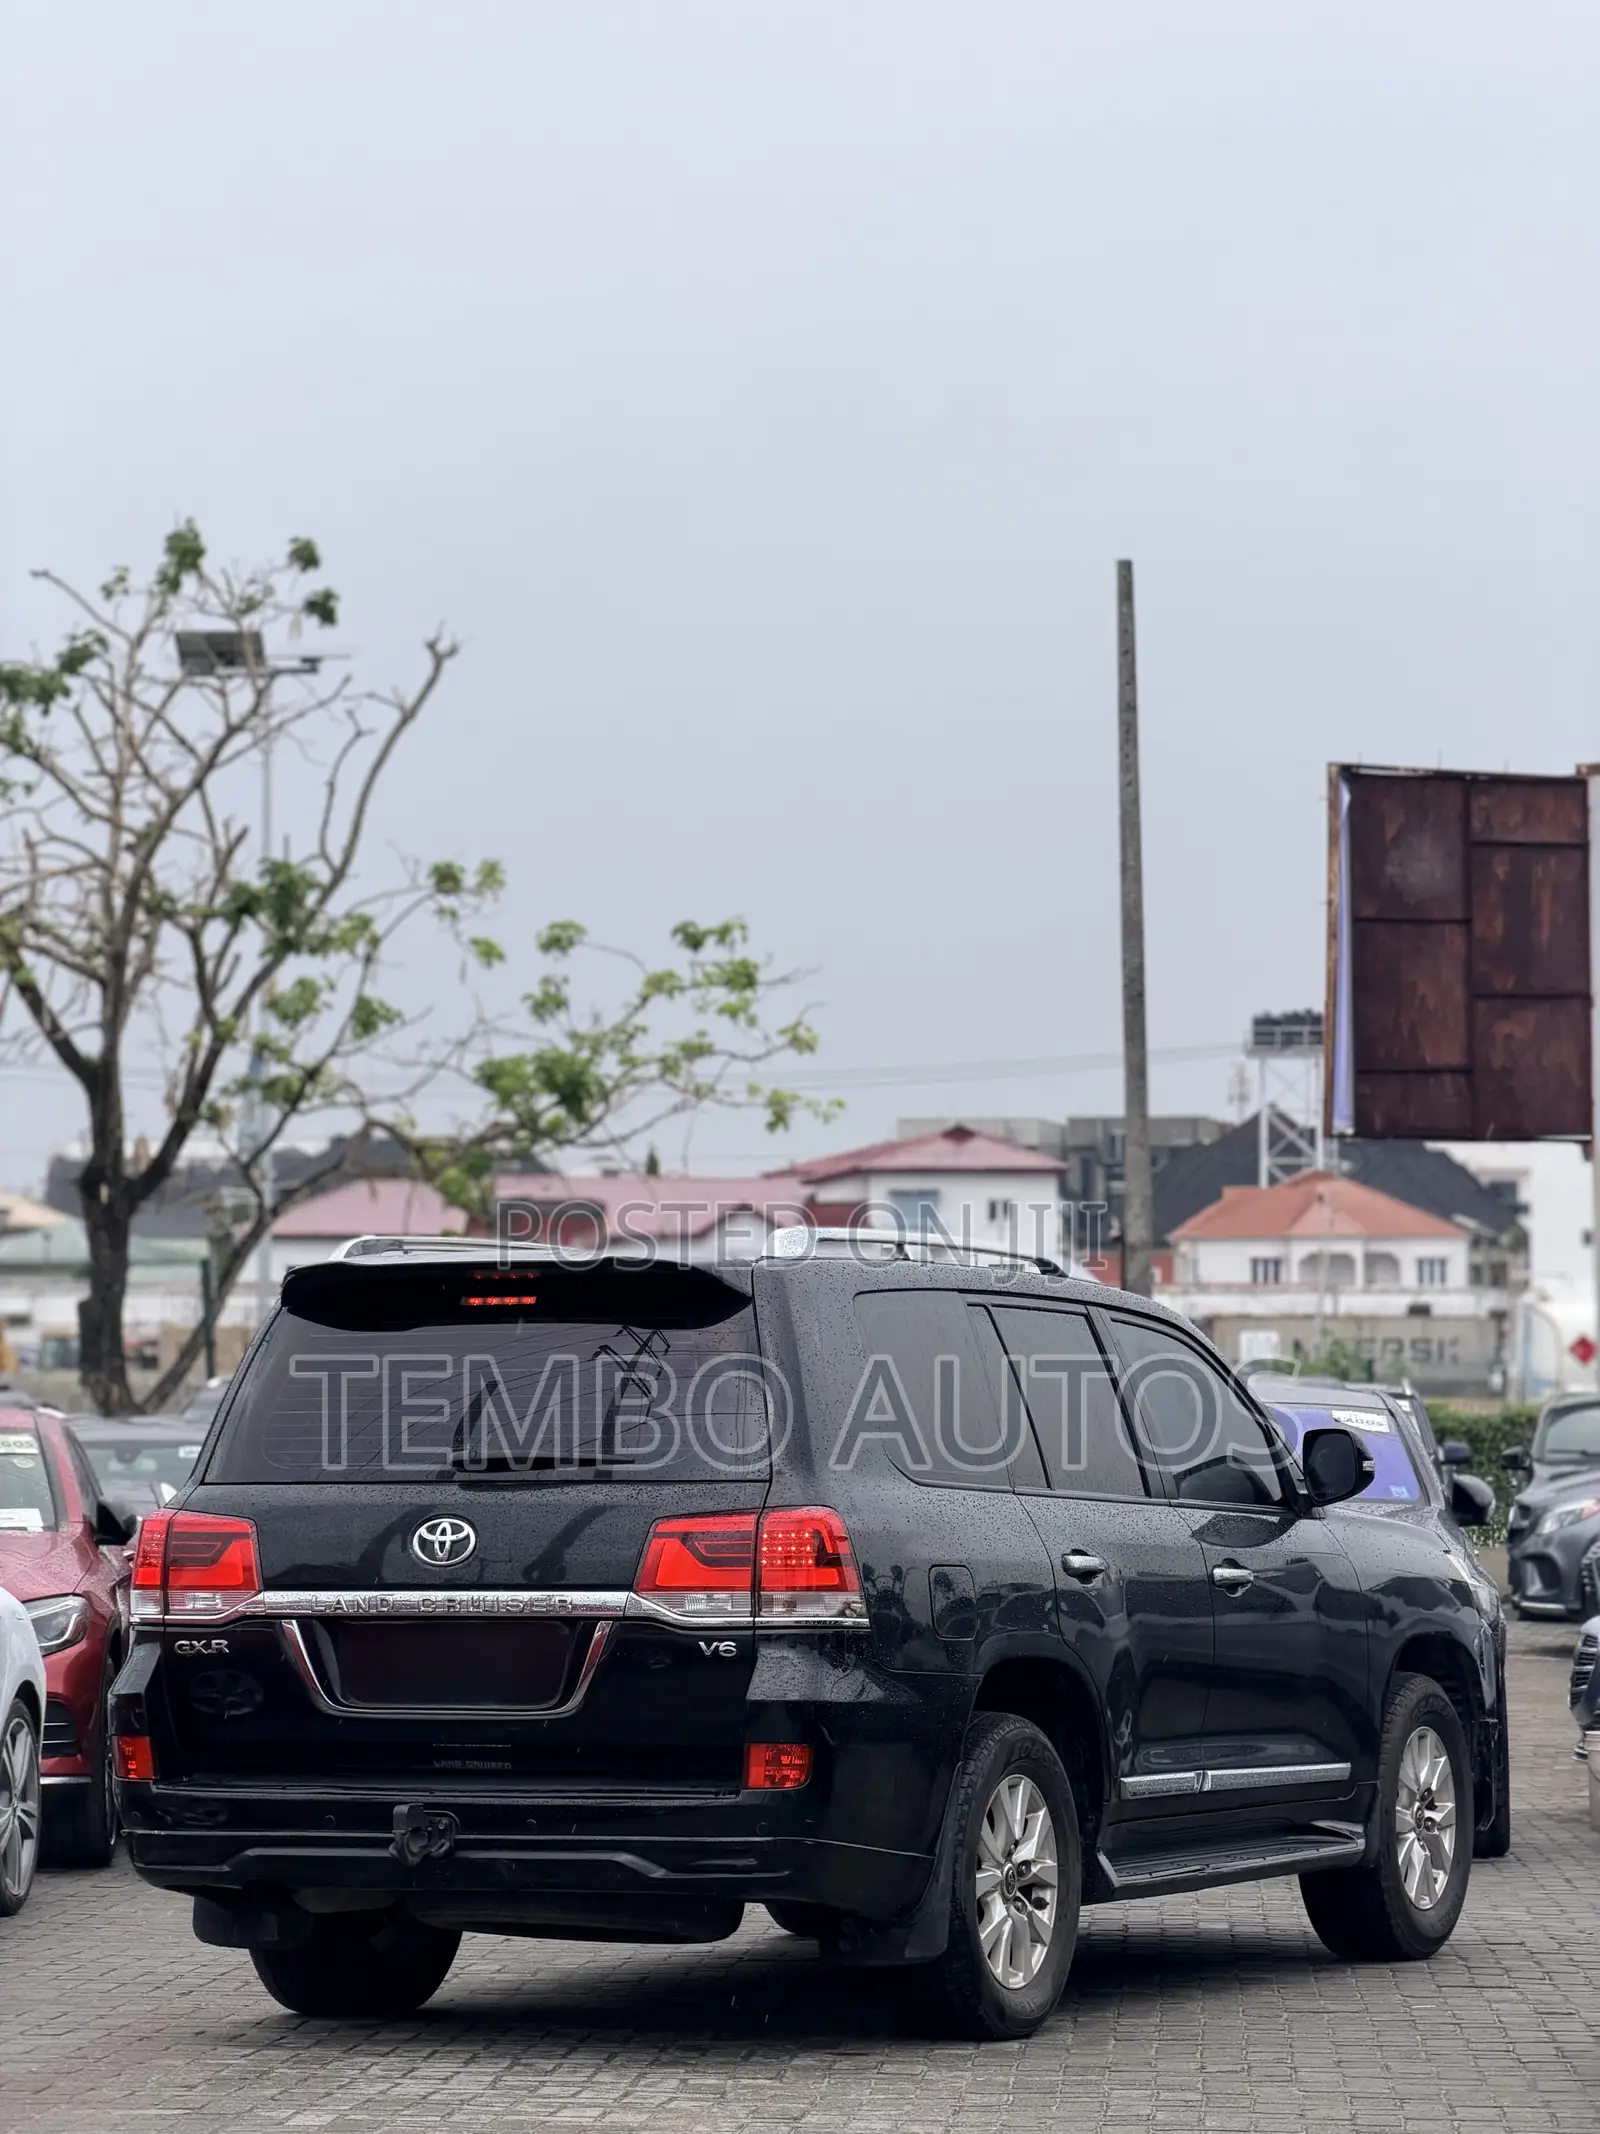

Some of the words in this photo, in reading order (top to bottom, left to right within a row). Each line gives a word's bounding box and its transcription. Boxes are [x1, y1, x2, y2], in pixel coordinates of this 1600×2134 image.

[0, 1439, 36, 1449] GOS
[311, 1594, 394, 1613] LAND
[418, 1594, 574, 1614] CRUISER
[174, 1639, 230, 1655] GXR
[698, 1641, 737, 1657] V6
